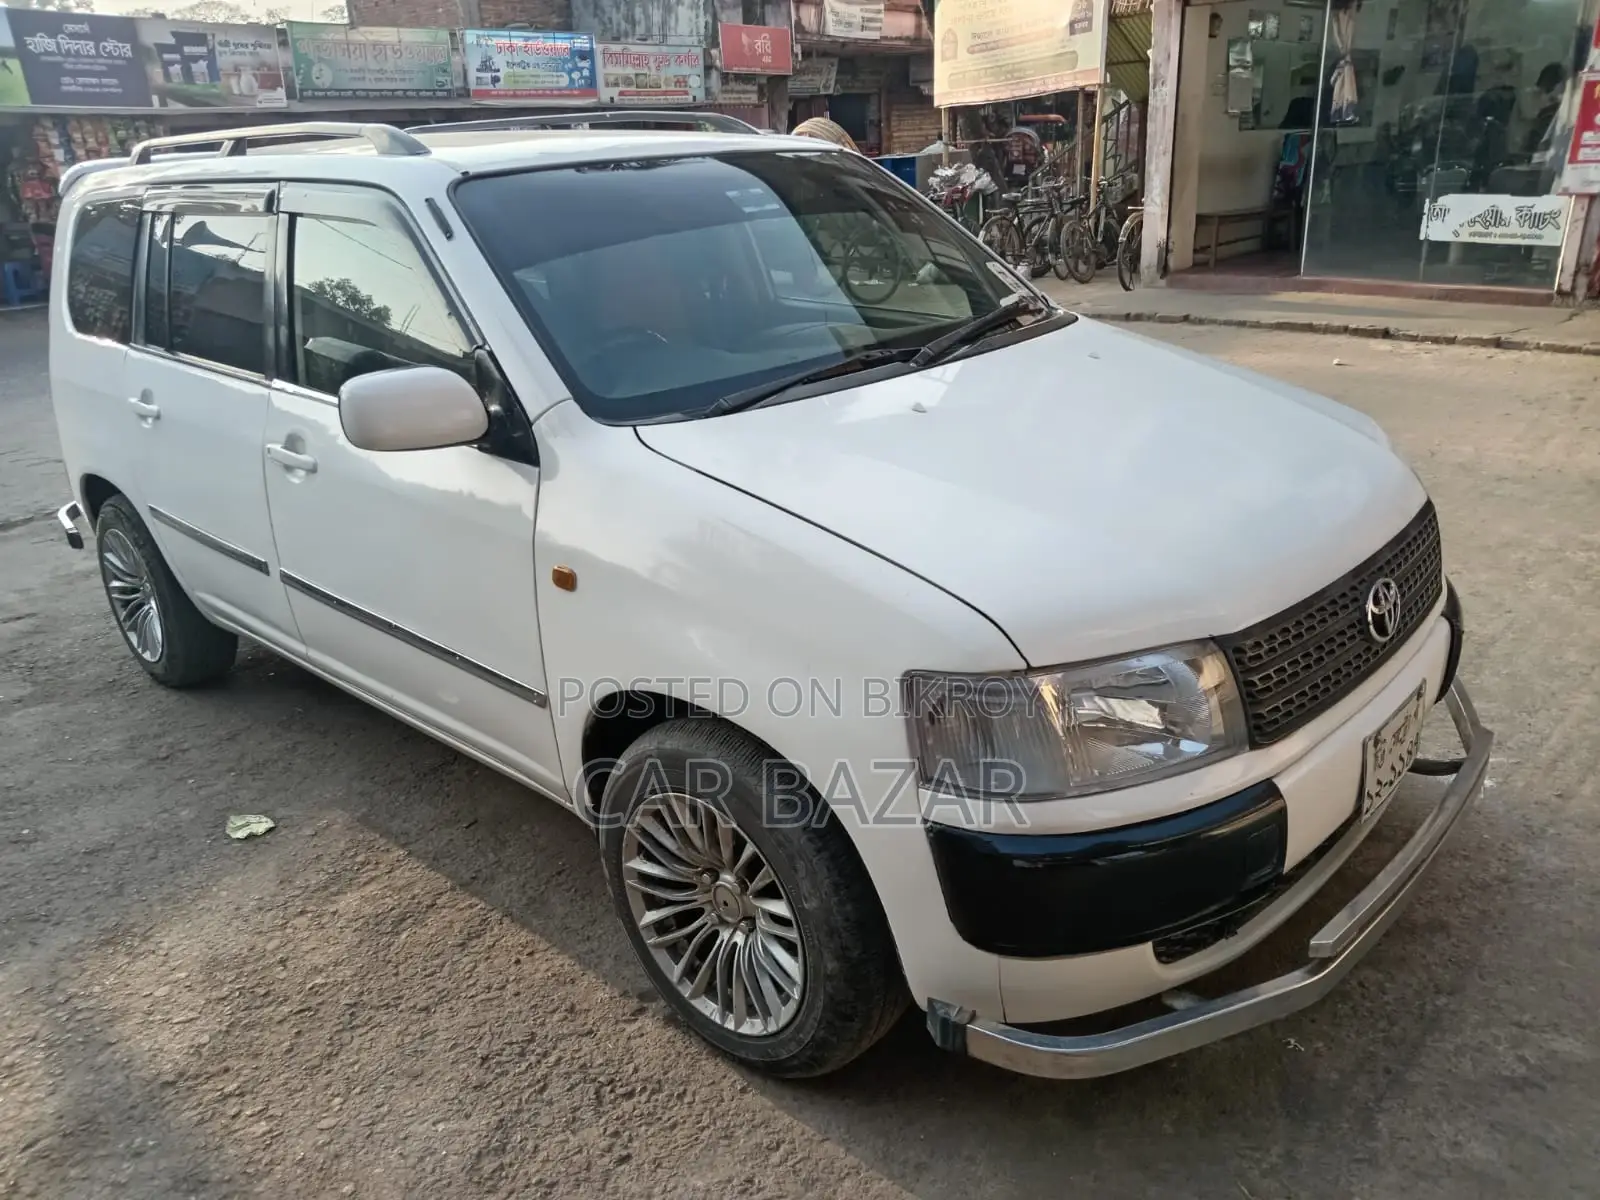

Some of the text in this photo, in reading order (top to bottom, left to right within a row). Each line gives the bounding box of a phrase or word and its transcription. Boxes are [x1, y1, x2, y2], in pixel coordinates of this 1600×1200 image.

[57, 34, 96, 57] দিদার
[99, 37, 133, 59] স্টোর
[495, 42, 519, 56] ঢাকা
[753, 33, 772, 56] রবি
